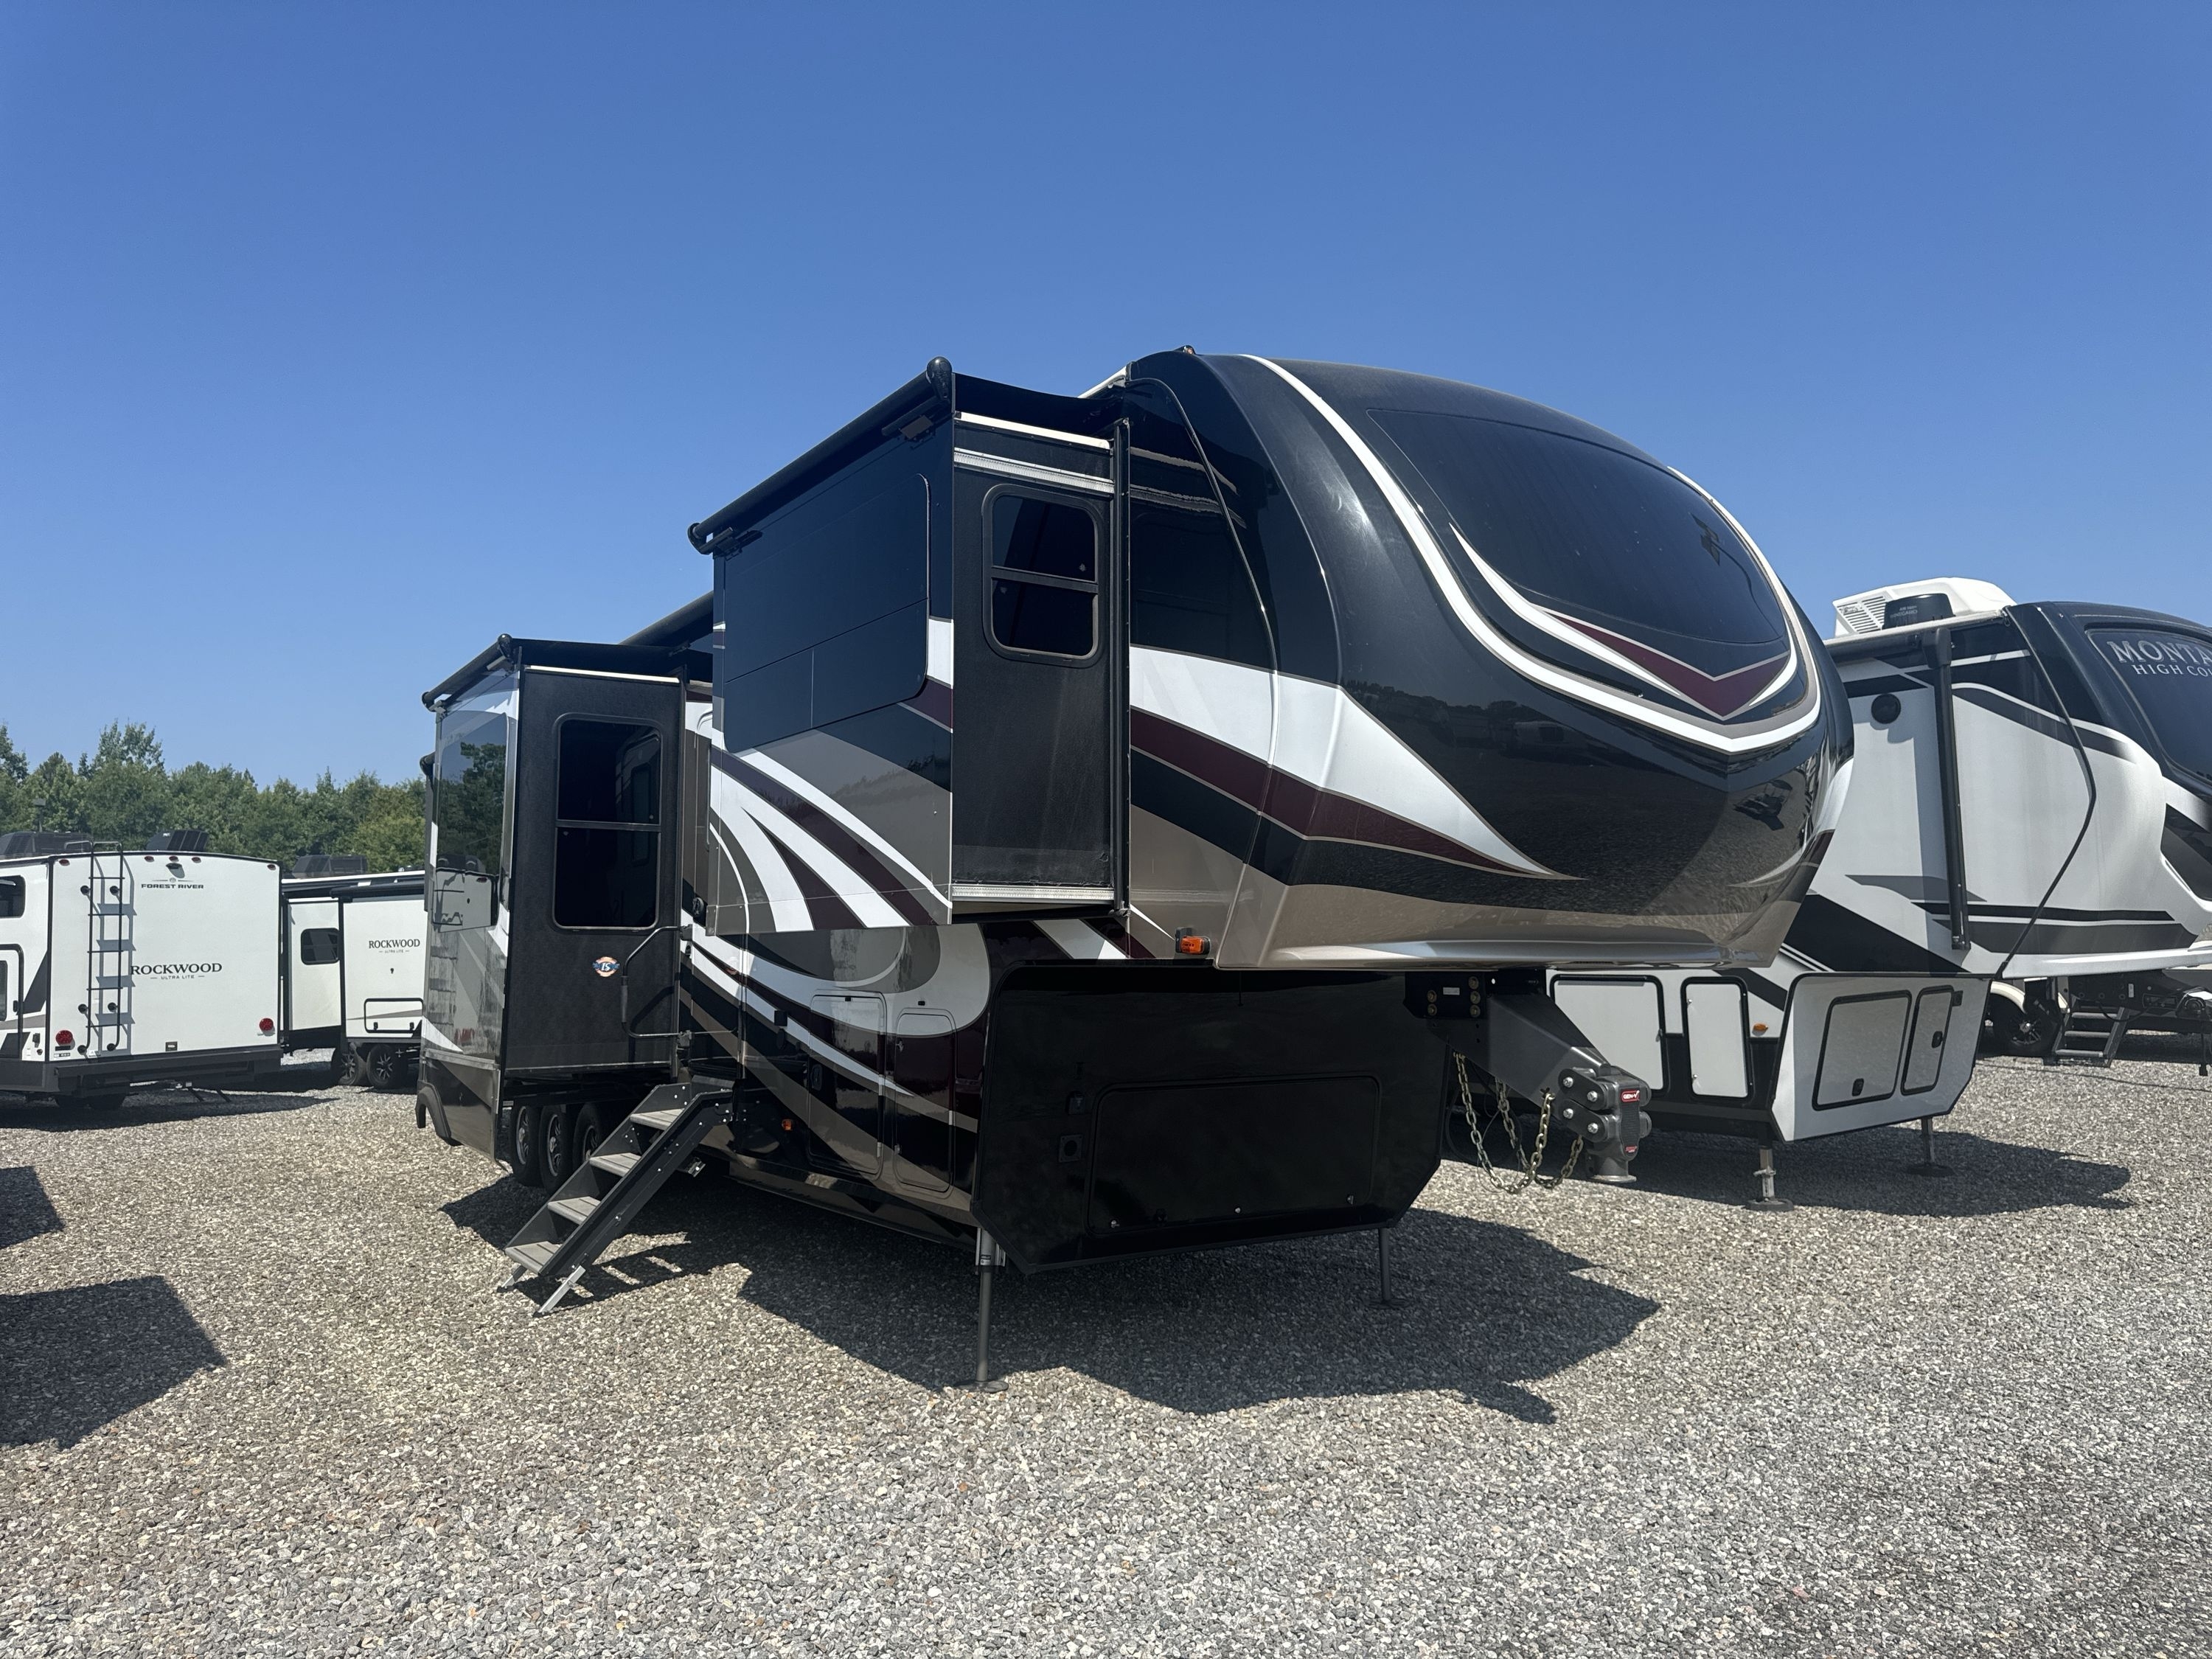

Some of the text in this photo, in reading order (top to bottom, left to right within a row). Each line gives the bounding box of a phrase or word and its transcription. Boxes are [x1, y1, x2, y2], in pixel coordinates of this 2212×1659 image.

[2107, 640, 2212, 667] MONTA
[2132, 664, 2184, 675] HIGH
[369, 939, 420, 949] ROCKWOOD
[131, 963, 223, 975] ROCKWOOD
